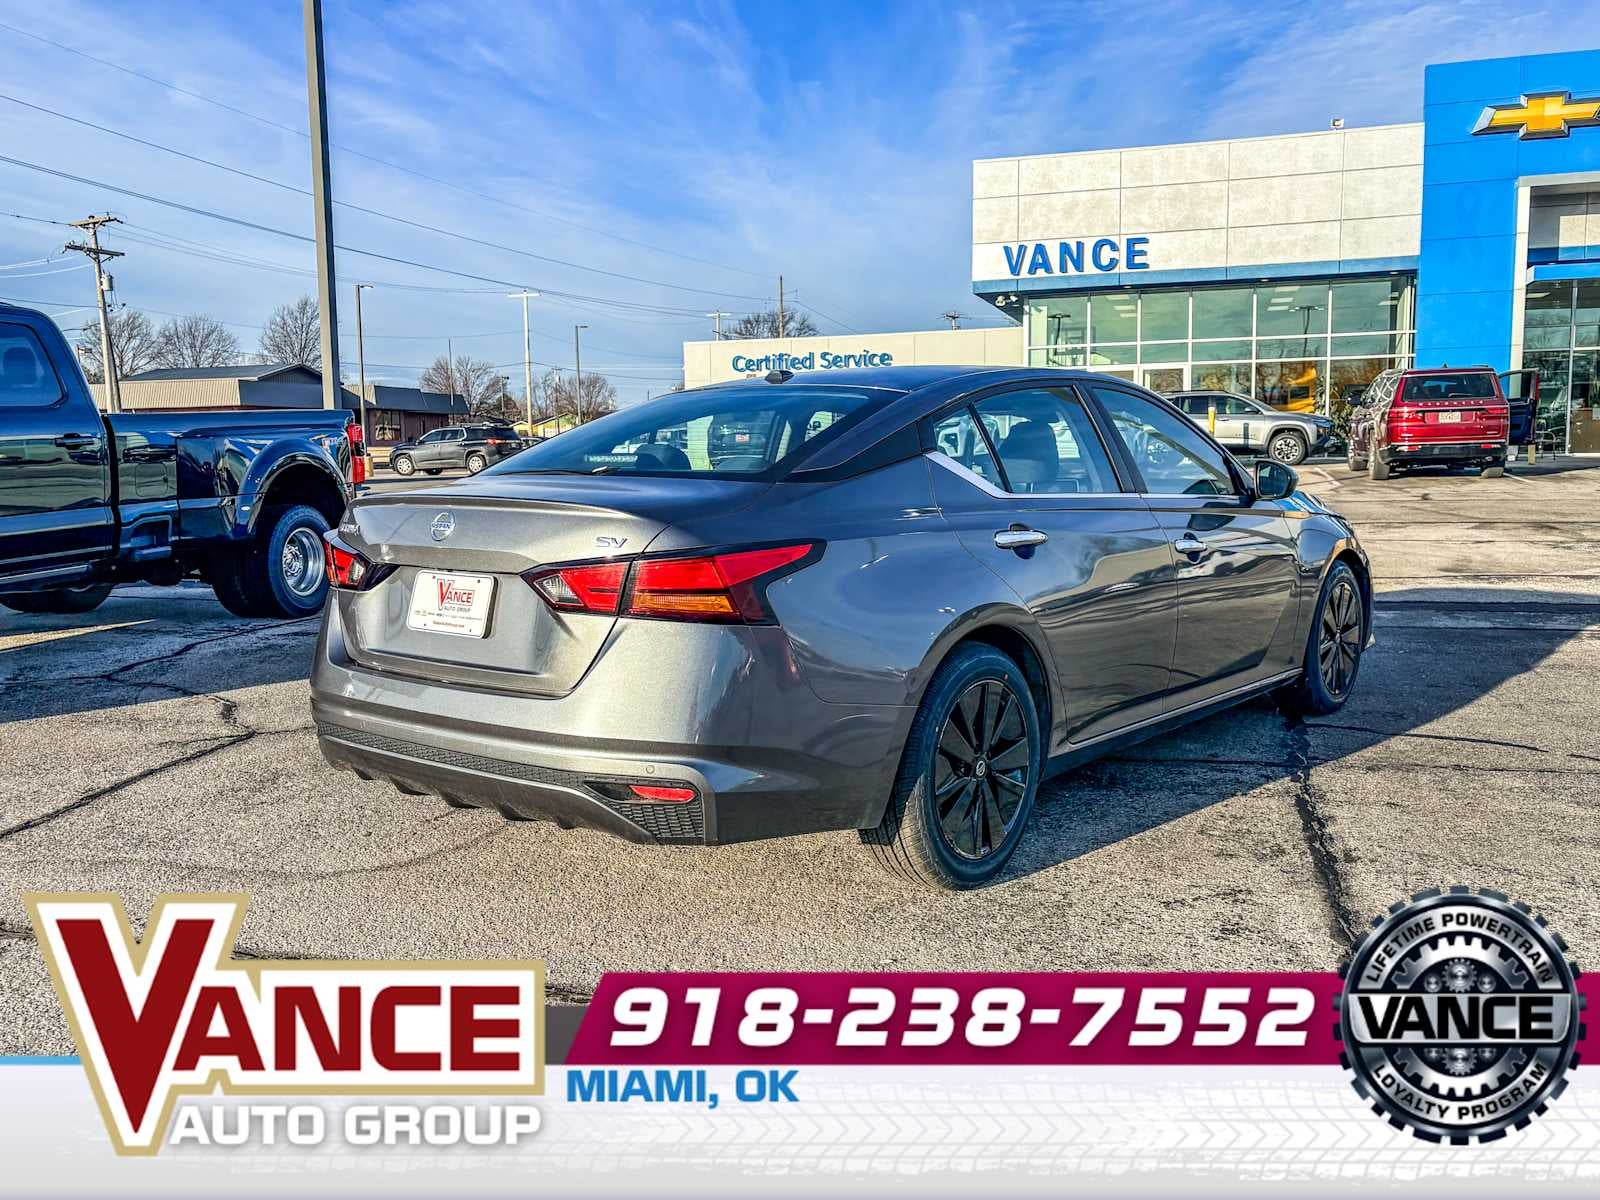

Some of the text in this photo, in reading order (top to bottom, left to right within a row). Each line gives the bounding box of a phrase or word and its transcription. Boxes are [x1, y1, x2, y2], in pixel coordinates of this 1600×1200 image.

[1003, 237, 1150, 276] VANCE
[732, 349, 893, 373] Certified Service
[595, 536, 628, 549] SV
[438, 580, 473, 608] VANCE
